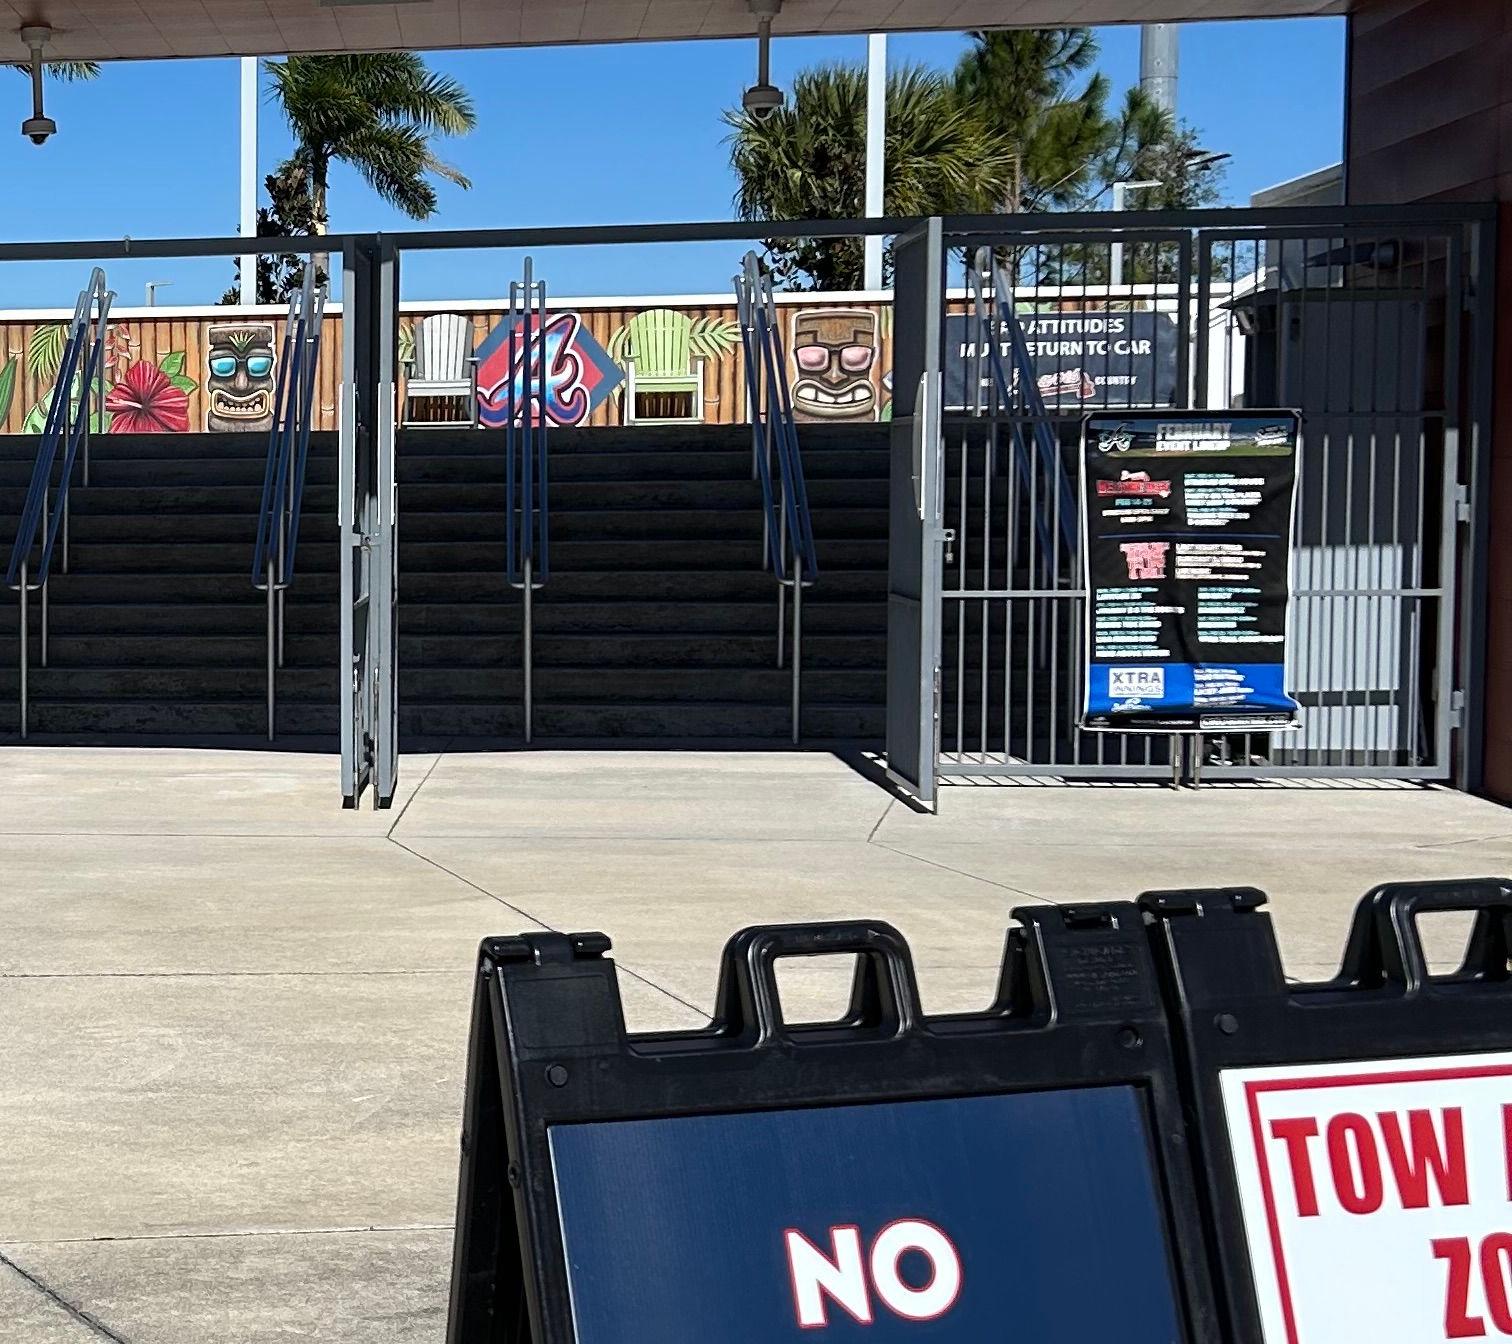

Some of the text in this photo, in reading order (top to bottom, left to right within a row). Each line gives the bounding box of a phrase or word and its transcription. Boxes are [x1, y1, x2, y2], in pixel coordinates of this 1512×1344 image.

[1027, 318, 1125, 335] ATTITUDES
[959, 339, 1152, 358] MUT ETURN TO CAR
[1112, 672, 1162, 684] XTRA
[1269, 1106, 1470, 1217] TOW
[784, 1217, 963, 1328] NO
